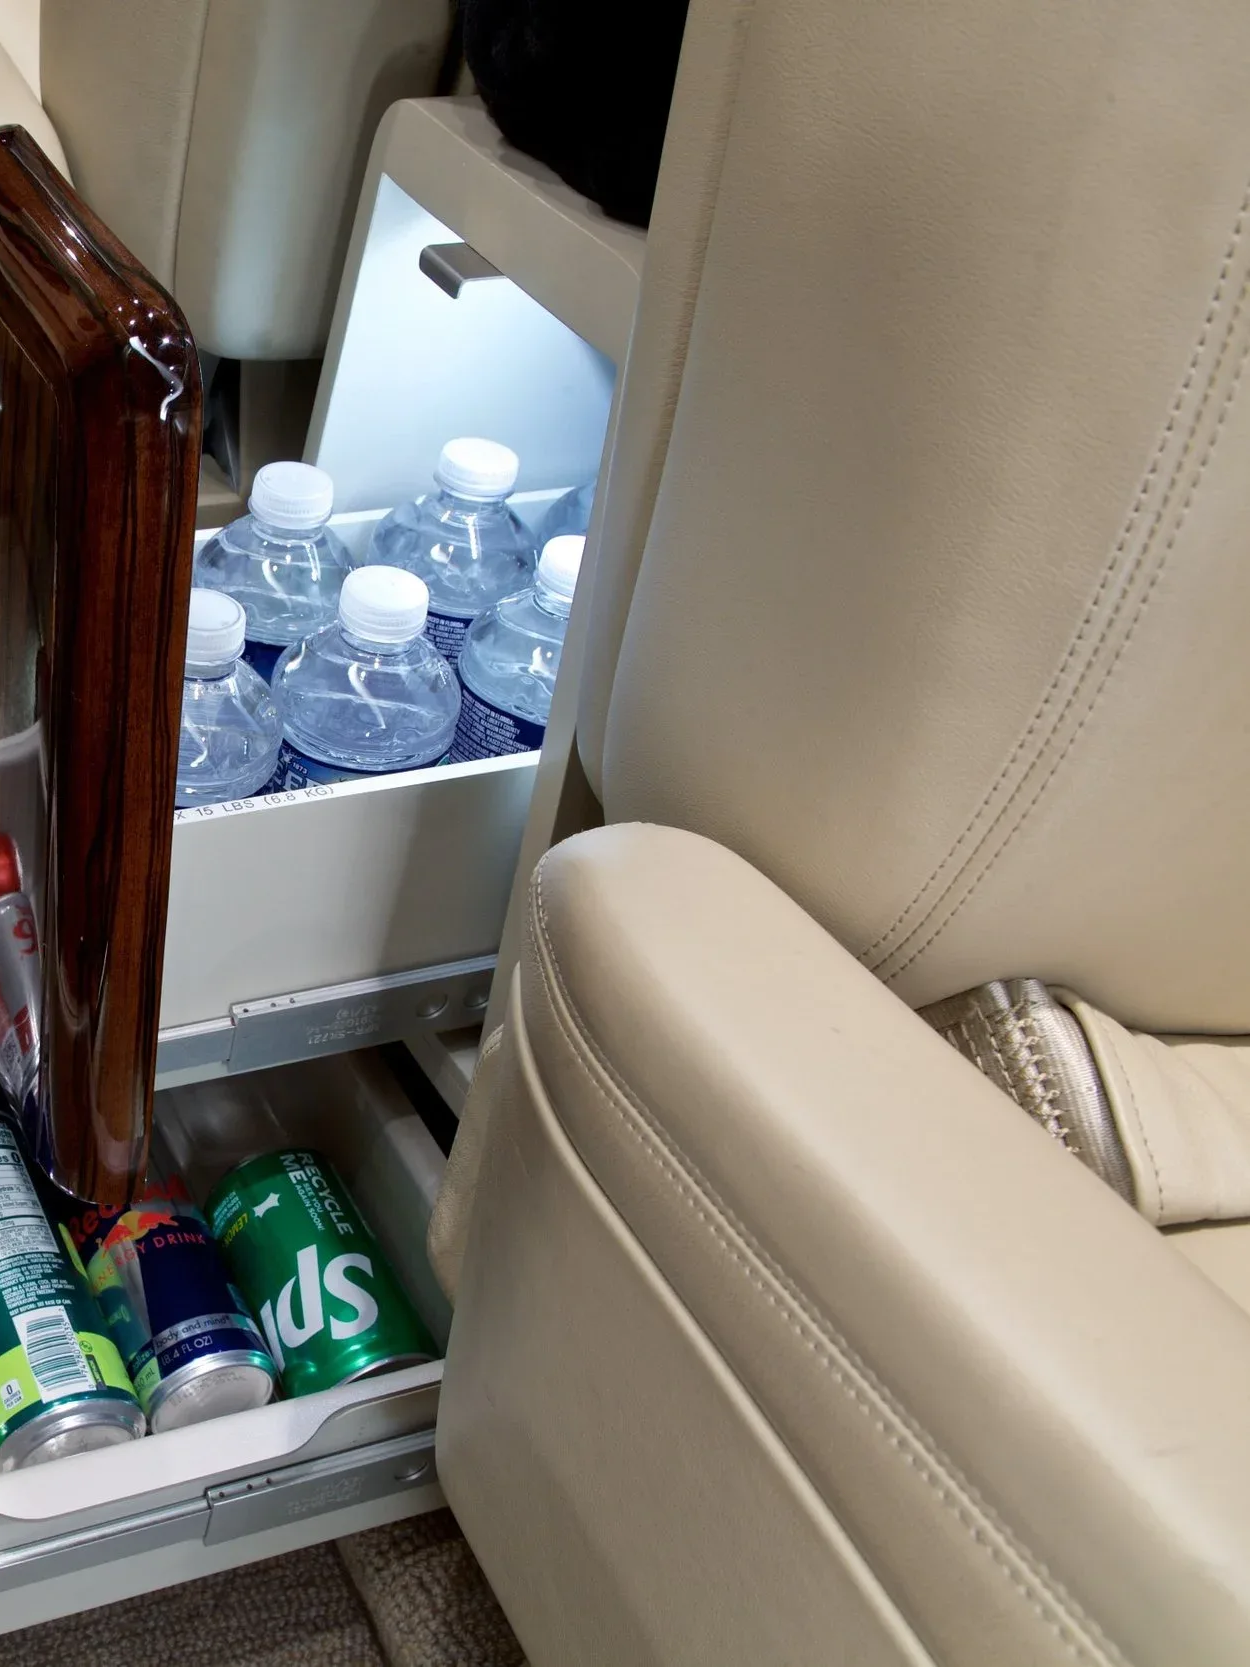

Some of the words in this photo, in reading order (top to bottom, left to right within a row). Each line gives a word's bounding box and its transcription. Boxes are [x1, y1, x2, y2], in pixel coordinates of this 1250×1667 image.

[497, 727, 516, 740] COUNTY
[502, 722, 521, 735] COUNTY
[196, 806, 213, 817] 15
[222, 799, 255, 812] LBS
[263, 792, 296, 806] (6.8
[304, 786, 334, 798] KG)
[11, 1152, 21, 1164] 0
[280, 1153, 309, 1185] ME
[297, 1152, 354, 1236] RECYCLE
[303, 1182, 315, 1197] SEE
[310, 1195, 324, 1214] YOU
[295, 1184, 312, 1208] AGAIN
[306, 1206, 325, 1232] SOON!
[152, 1232, 207, 1249] DRINK
[155, 1330, 180, 1348] body
[181, 1320, 202, 1333] and
[181, 1344, 193, 1355] FL
[193, 1335, 213, 1348] OZ)
[6, 1384, 13, 1395] 0
